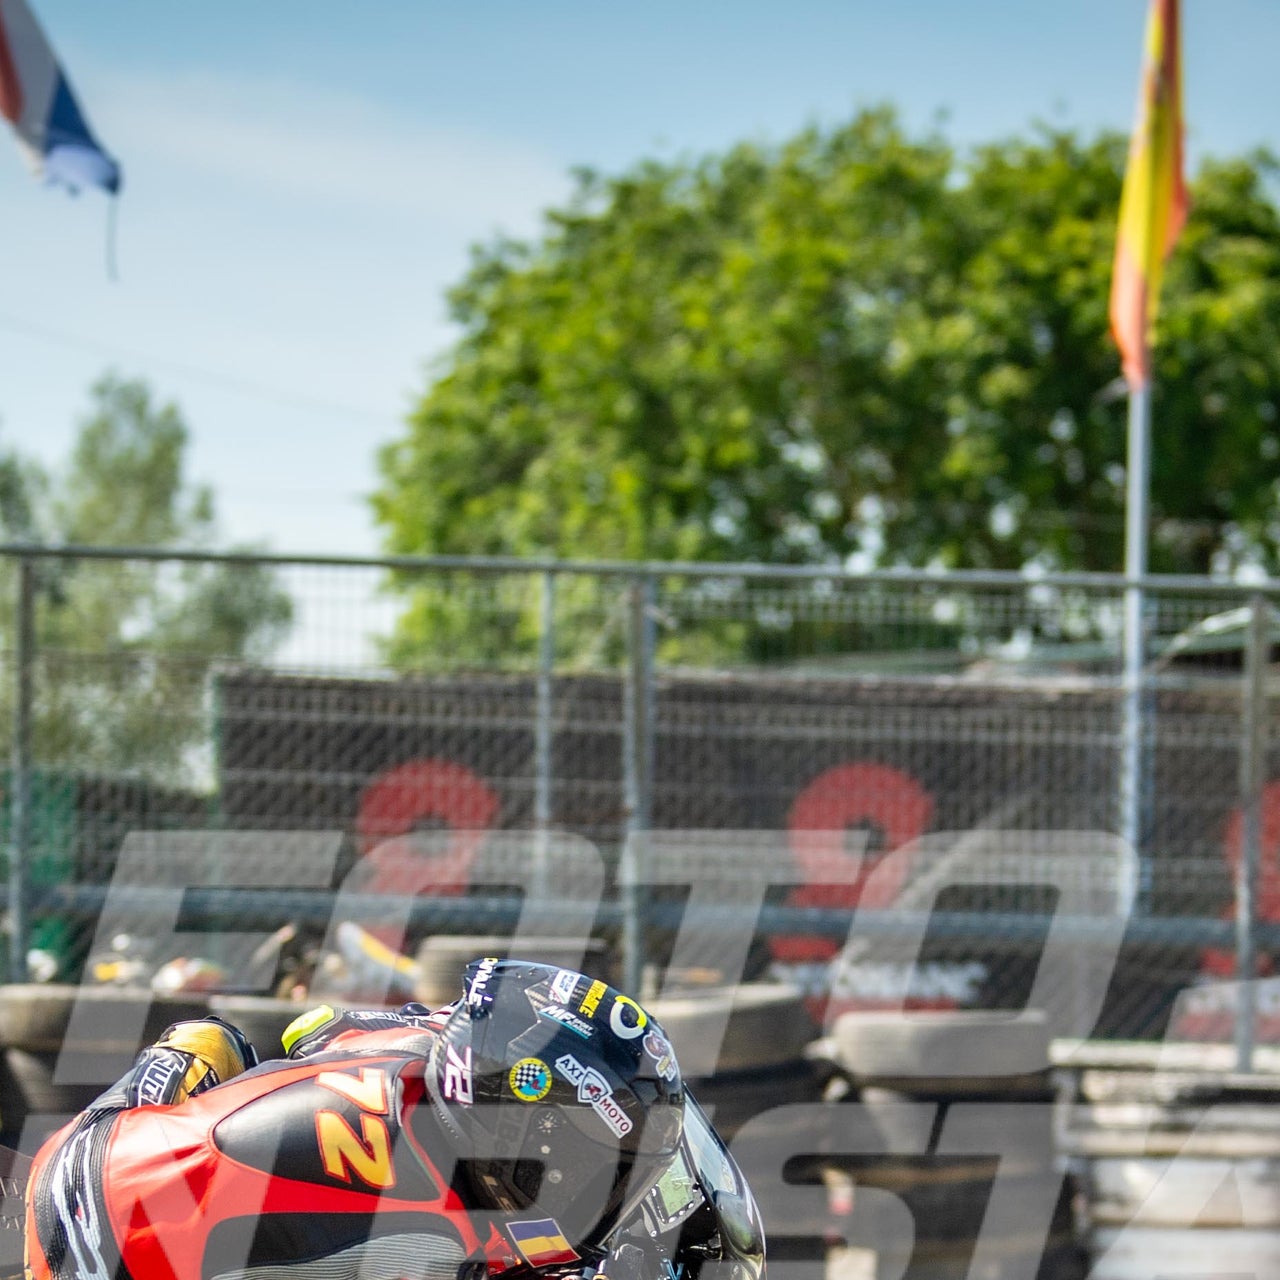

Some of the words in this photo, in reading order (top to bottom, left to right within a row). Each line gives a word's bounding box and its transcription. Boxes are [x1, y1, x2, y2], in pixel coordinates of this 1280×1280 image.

[443, 1043, 474, 1107] 72
[561, 1058, 583, 1081] AXI
[315, 1066, 397, 1190] 72
[599, 1099, 631, 1134] MOTO
